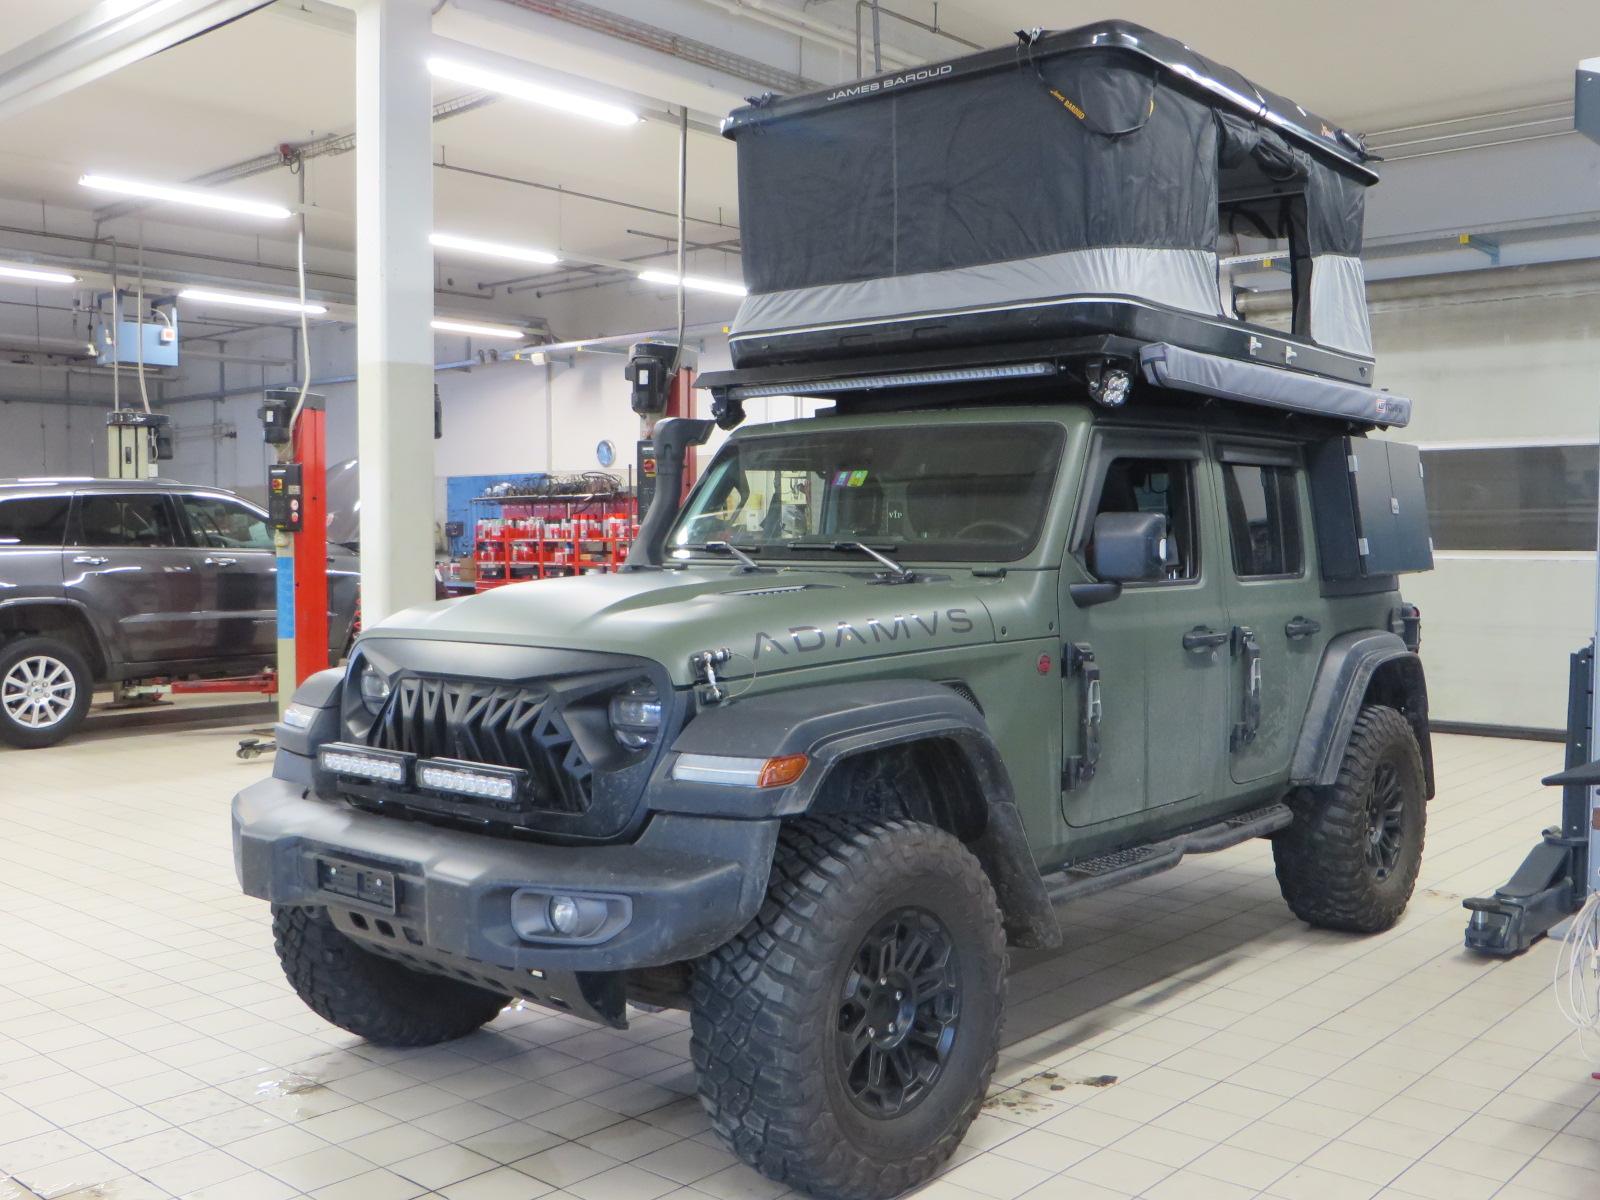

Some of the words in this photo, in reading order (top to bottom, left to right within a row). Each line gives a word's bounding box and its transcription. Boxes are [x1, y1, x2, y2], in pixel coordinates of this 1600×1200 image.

[827, 82, 880, 101] JAMES
[883, 64, 953, 88] BAROUD
[752, 607, 974, 660] ADAMVS
